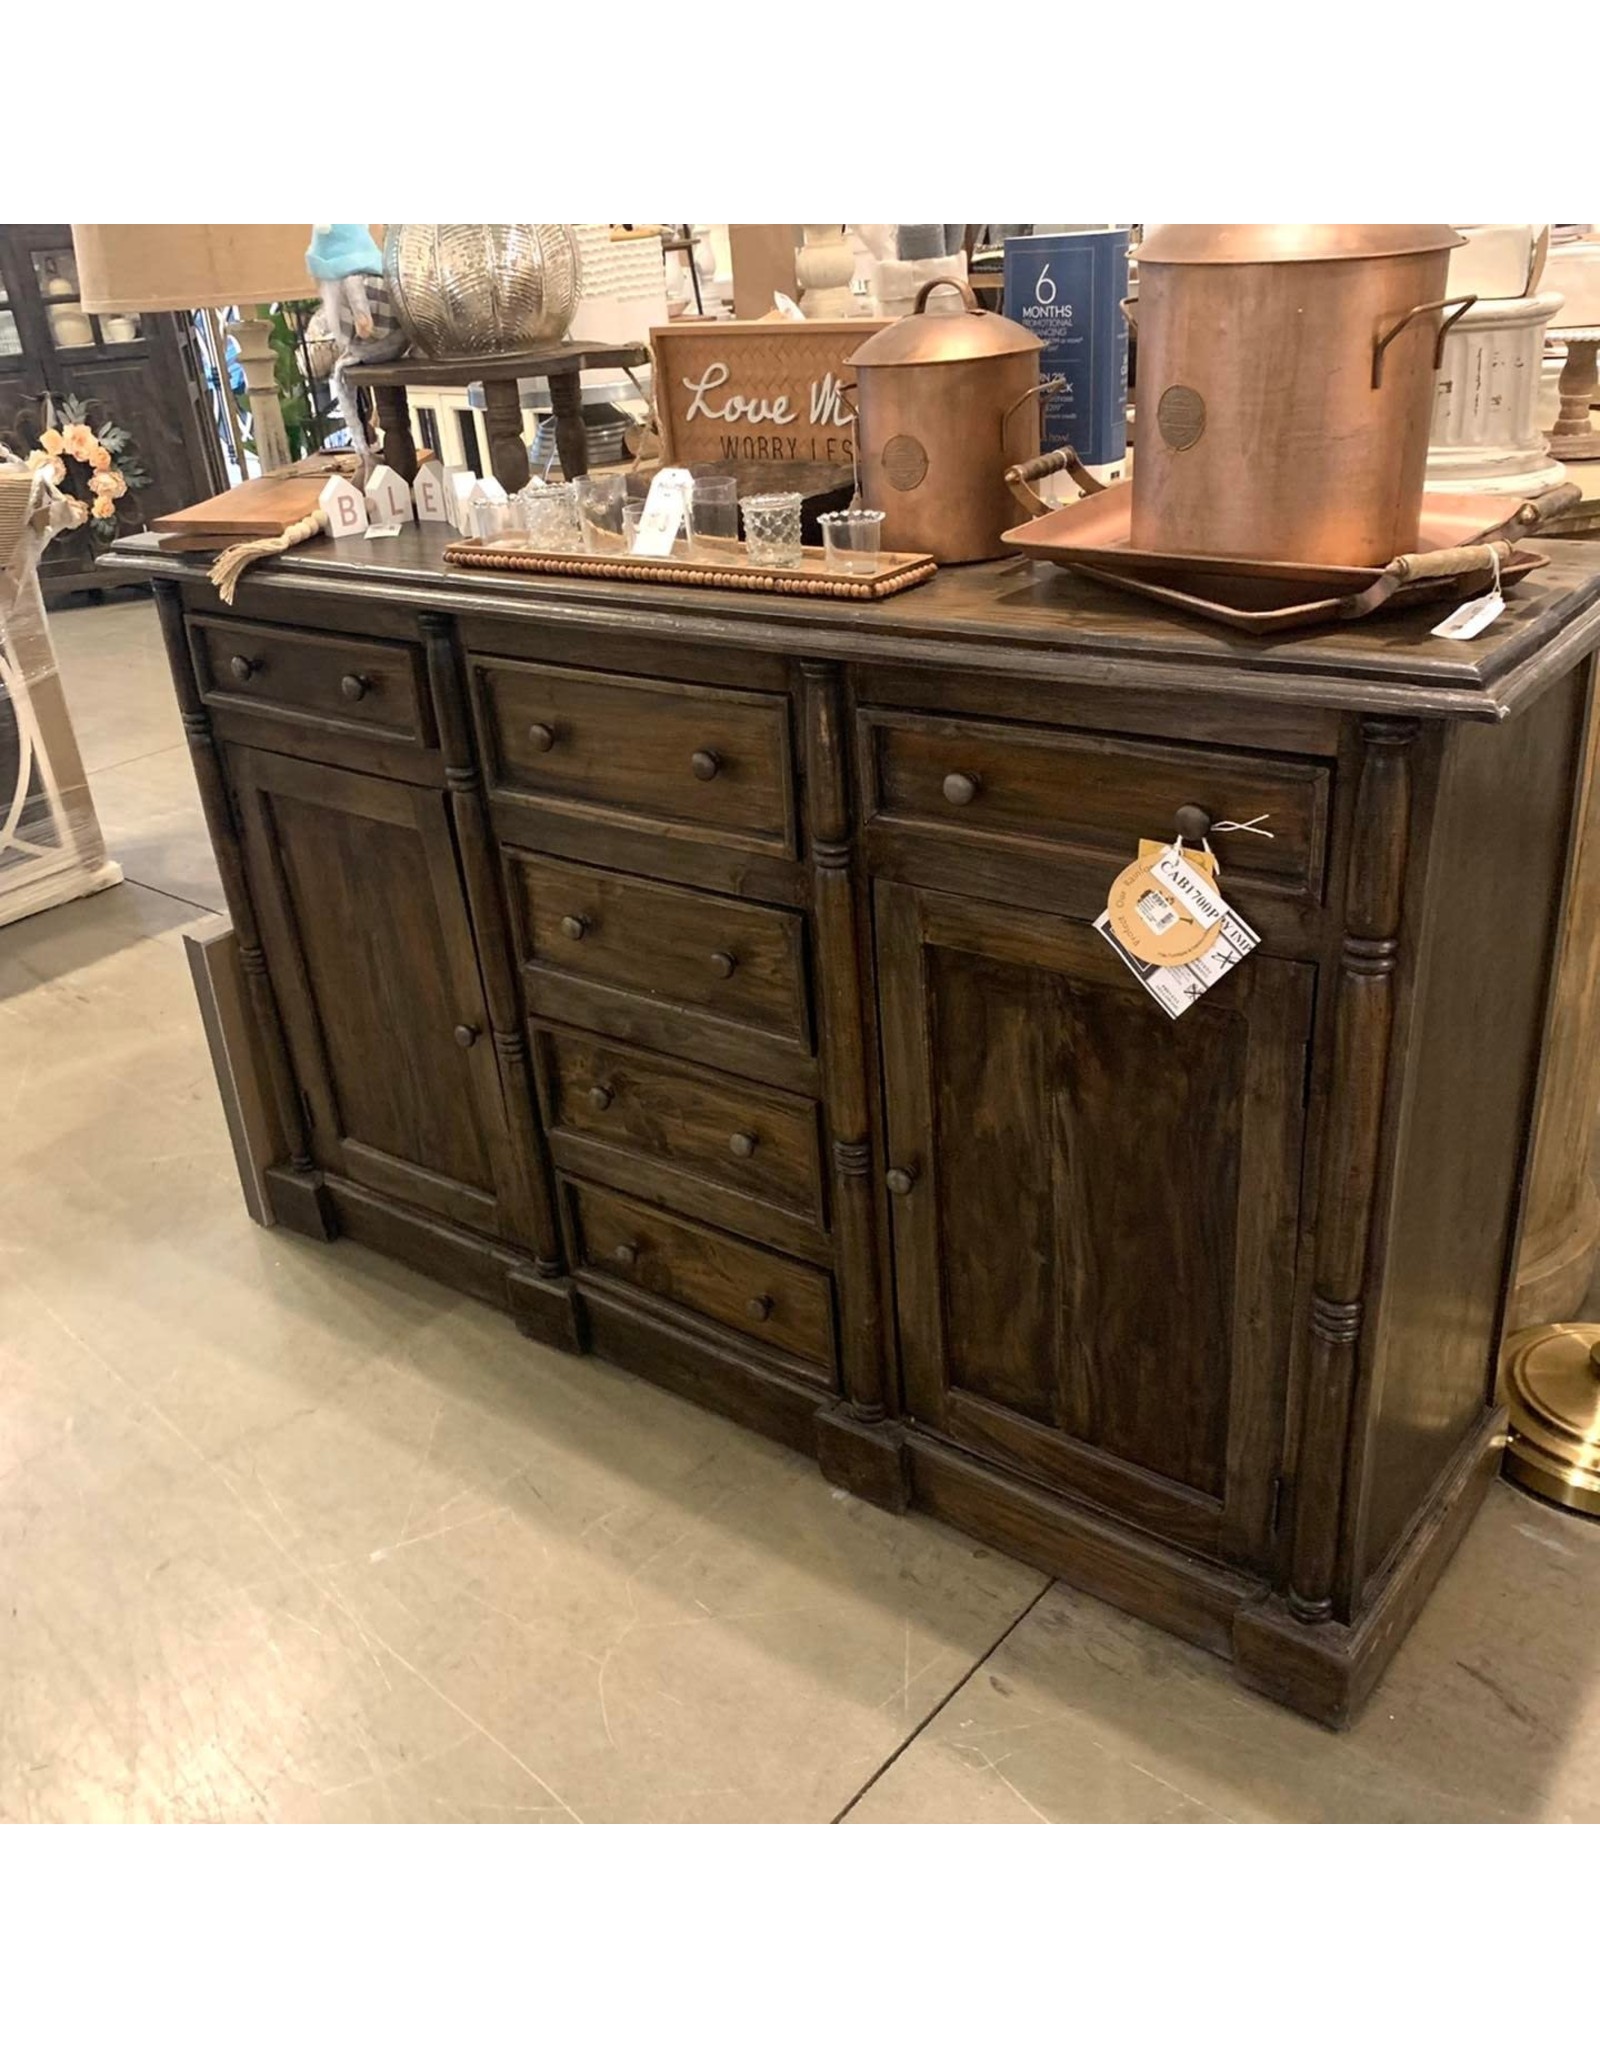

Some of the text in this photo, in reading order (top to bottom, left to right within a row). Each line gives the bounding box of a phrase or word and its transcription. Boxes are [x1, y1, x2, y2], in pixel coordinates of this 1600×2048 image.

[1035, 263, 1057, 304] 6
[1022, 305, 1073, 318] MONTHS
[682, 362, 797, 425] Love
[720, 436, 797, 460] WORRY
[1160, 859, 1220, 918] CAB1700P
